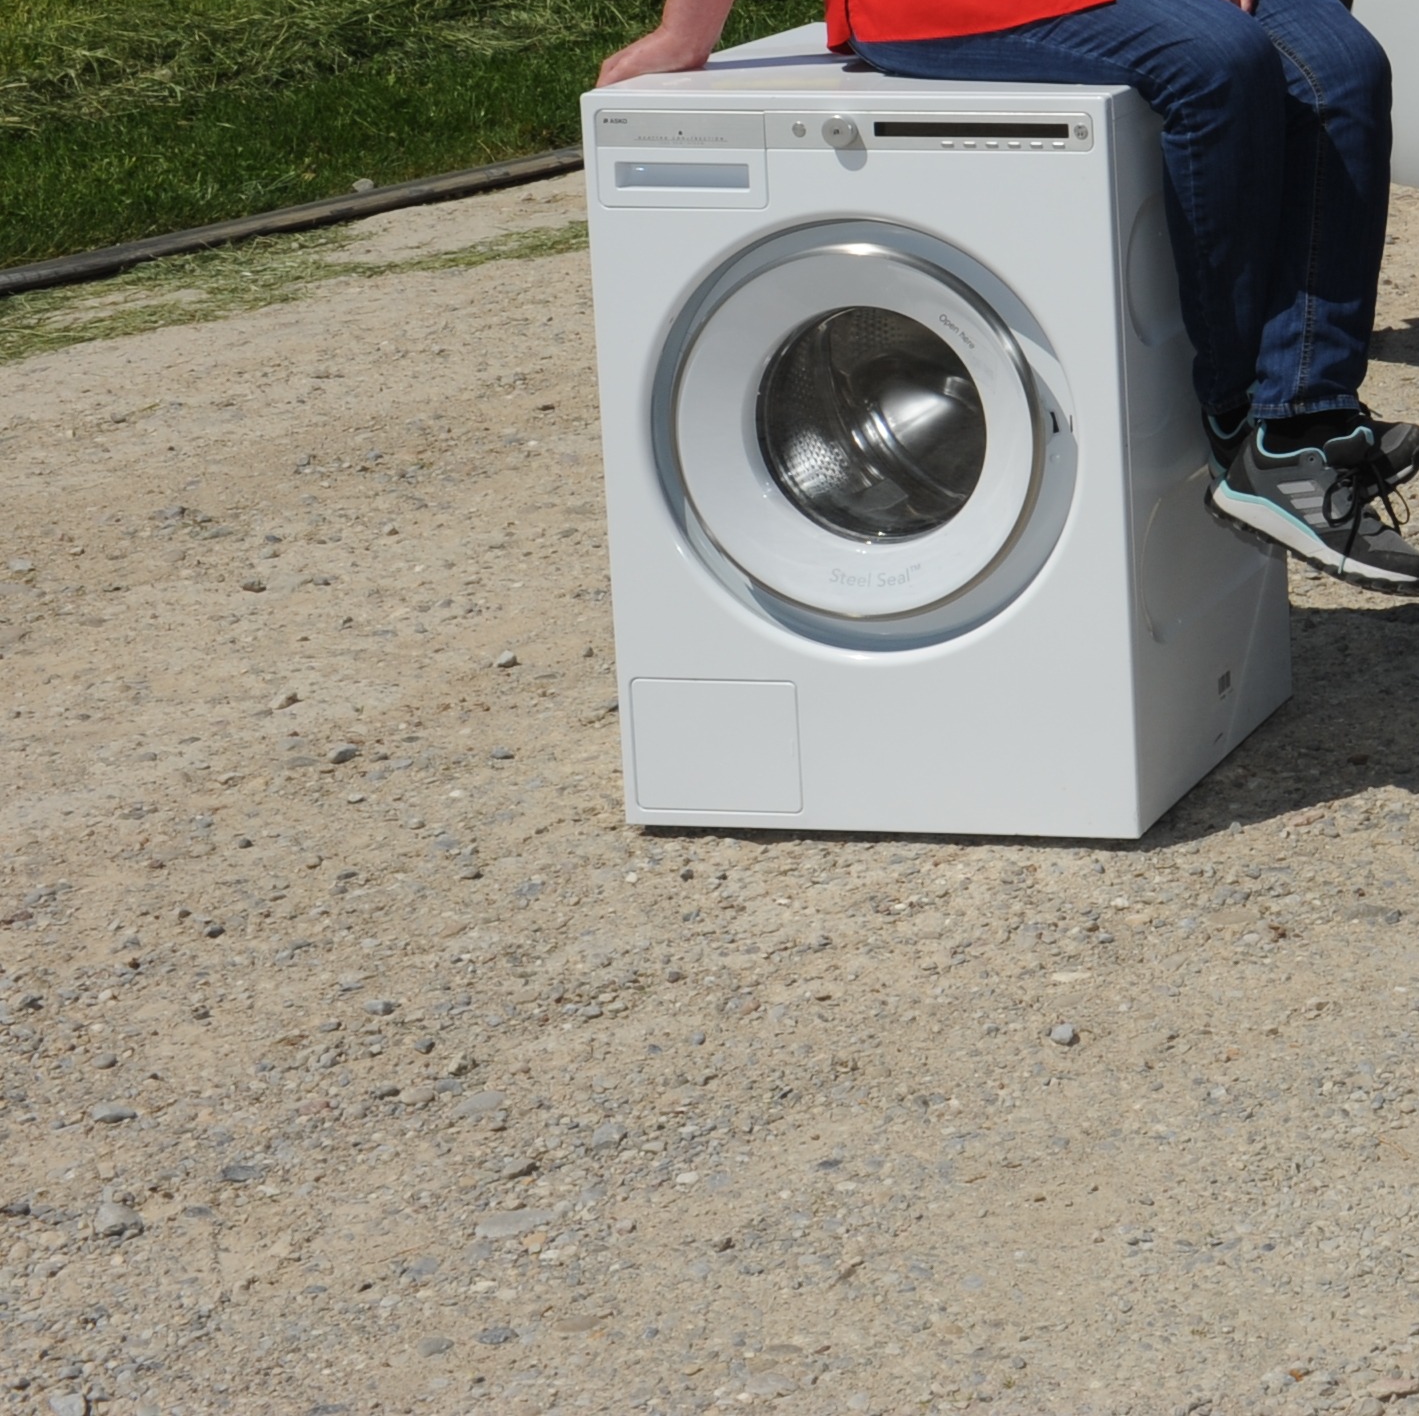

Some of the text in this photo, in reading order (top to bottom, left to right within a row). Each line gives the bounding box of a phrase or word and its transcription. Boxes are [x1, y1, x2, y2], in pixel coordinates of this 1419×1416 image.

[939, 313, 976, 350] Open here
[829, 568, 872, 588] Steel
